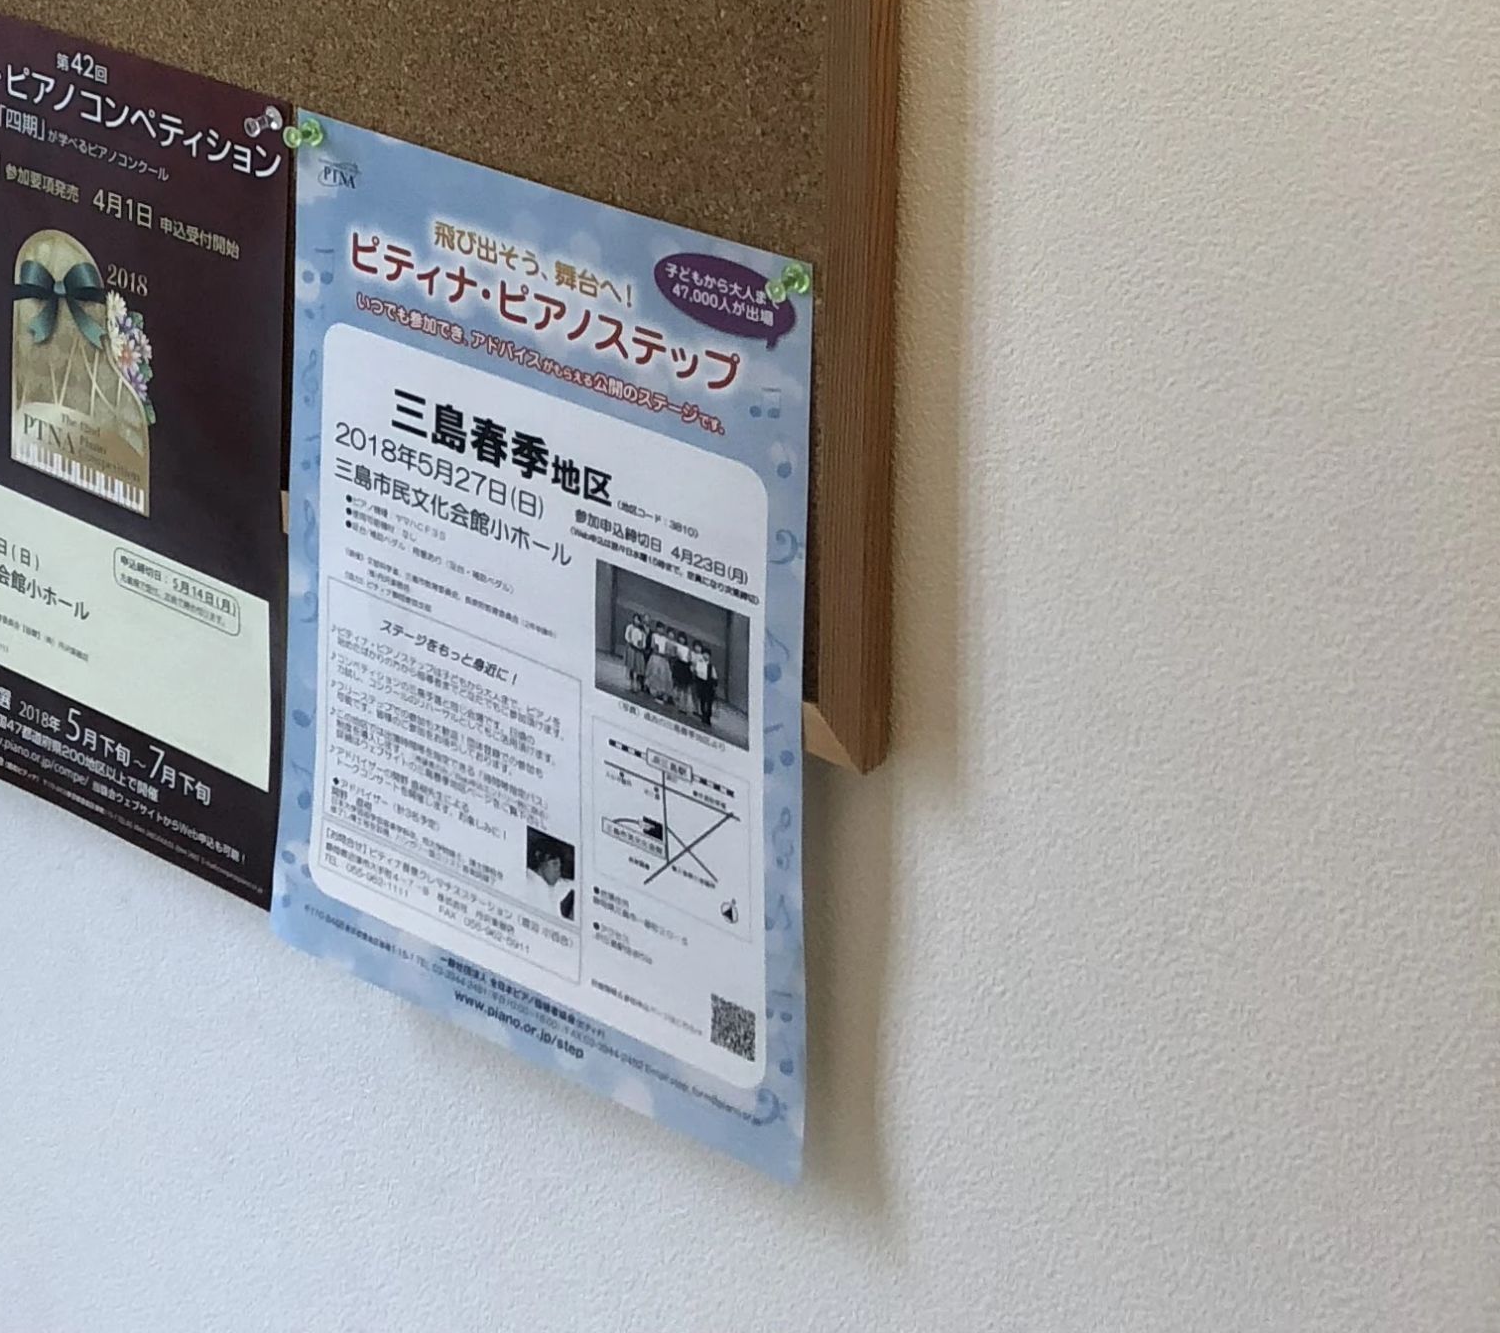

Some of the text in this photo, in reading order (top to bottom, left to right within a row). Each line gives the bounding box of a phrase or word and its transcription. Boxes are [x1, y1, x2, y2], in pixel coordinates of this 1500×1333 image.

[56, 52, 109, 85] 第42回
[322, 164, 358, 190] PTNA
[92, 189, 154, 229] 4月1日
[160, 216, 240, 260] 申込受付開始
[106, 263, 149, 298] 2018
[433, 219, 633, 308] 飛び出そう、舞台へ！
[350, 232, 741, 390] ピティナ・ピアノステップ
[23, 413, 76, 455] PTNA
[391, 388, 613, 506] 三島春季地区
[334, 457, 573, 567] 三島市民文化会館小ホール
[335, 422, 545, 520] 2018年5月27日（日）
[574, 508, 663, 554] 参加申込締切日
[380, 620, 518, 686] ステージをもっと身近に！
[20, 699, 62, 734] 2018年
[454, 990, 584, 1059] www.piano.or.jp/step
